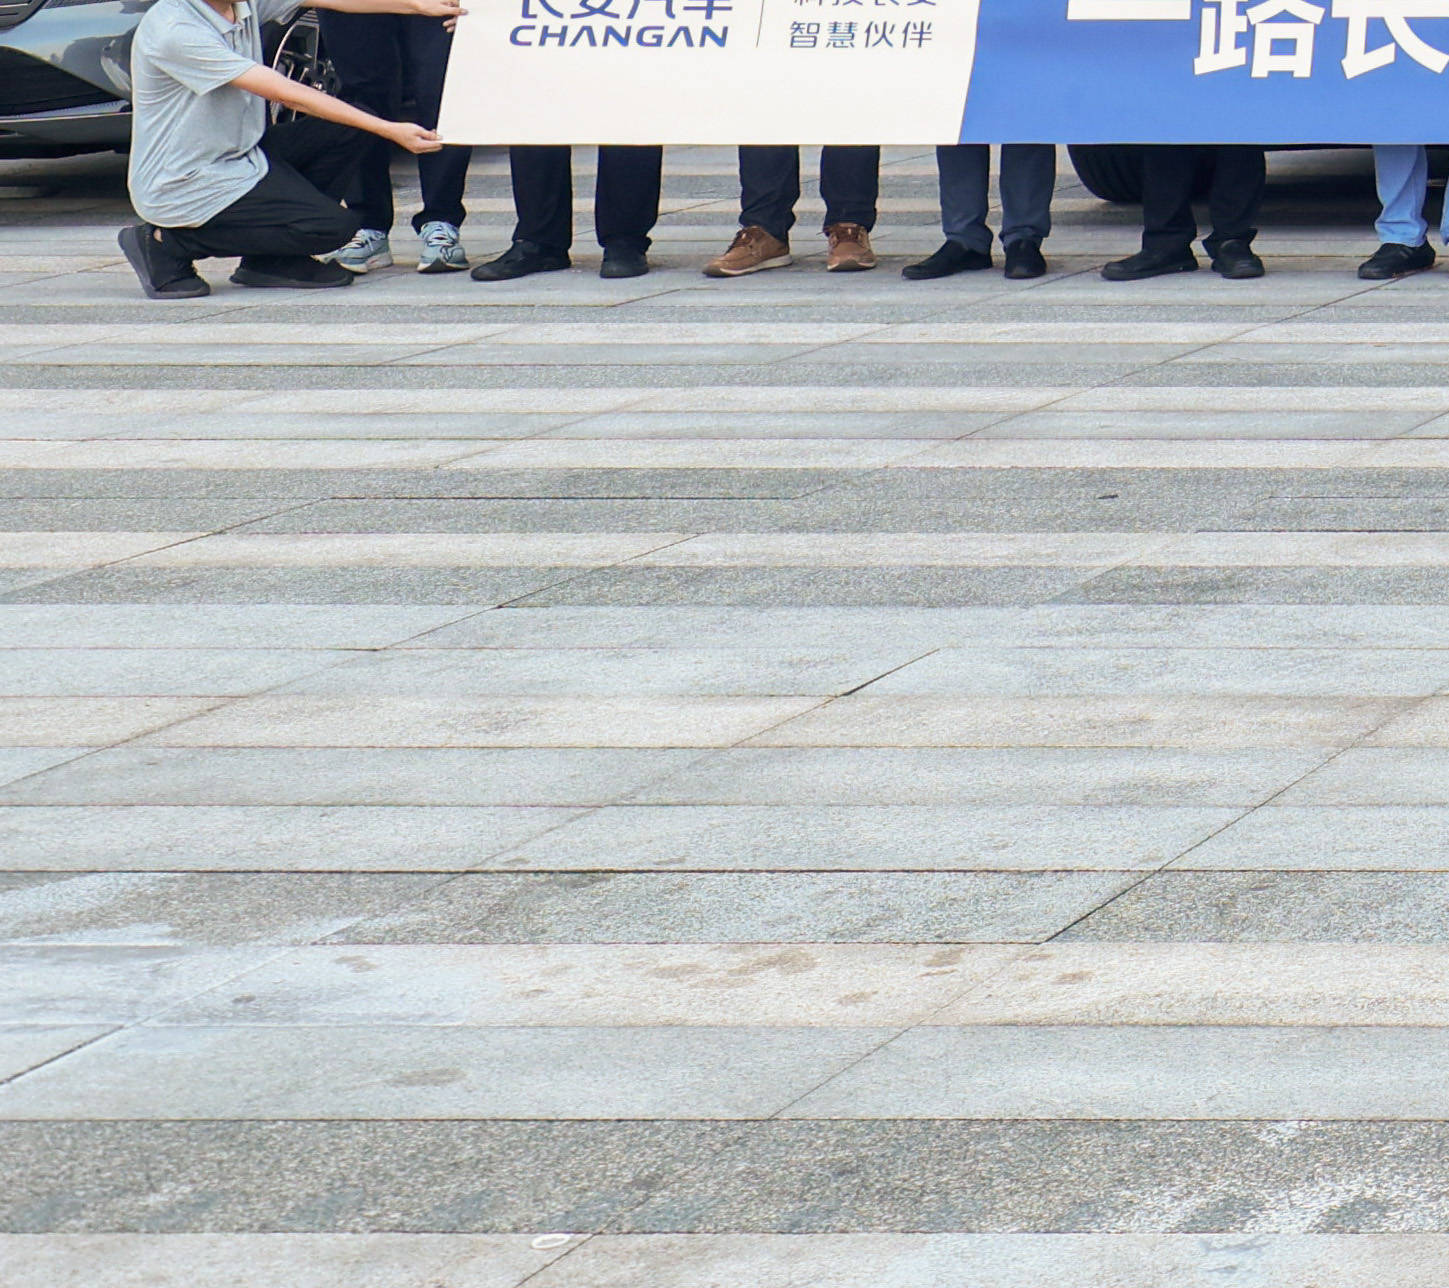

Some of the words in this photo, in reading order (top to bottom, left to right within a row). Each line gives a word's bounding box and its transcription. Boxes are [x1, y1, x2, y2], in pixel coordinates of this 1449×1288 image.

[509, 24, 729, 48] CHANGAN
[790, 20, 932, 48] 智慧伙伴
